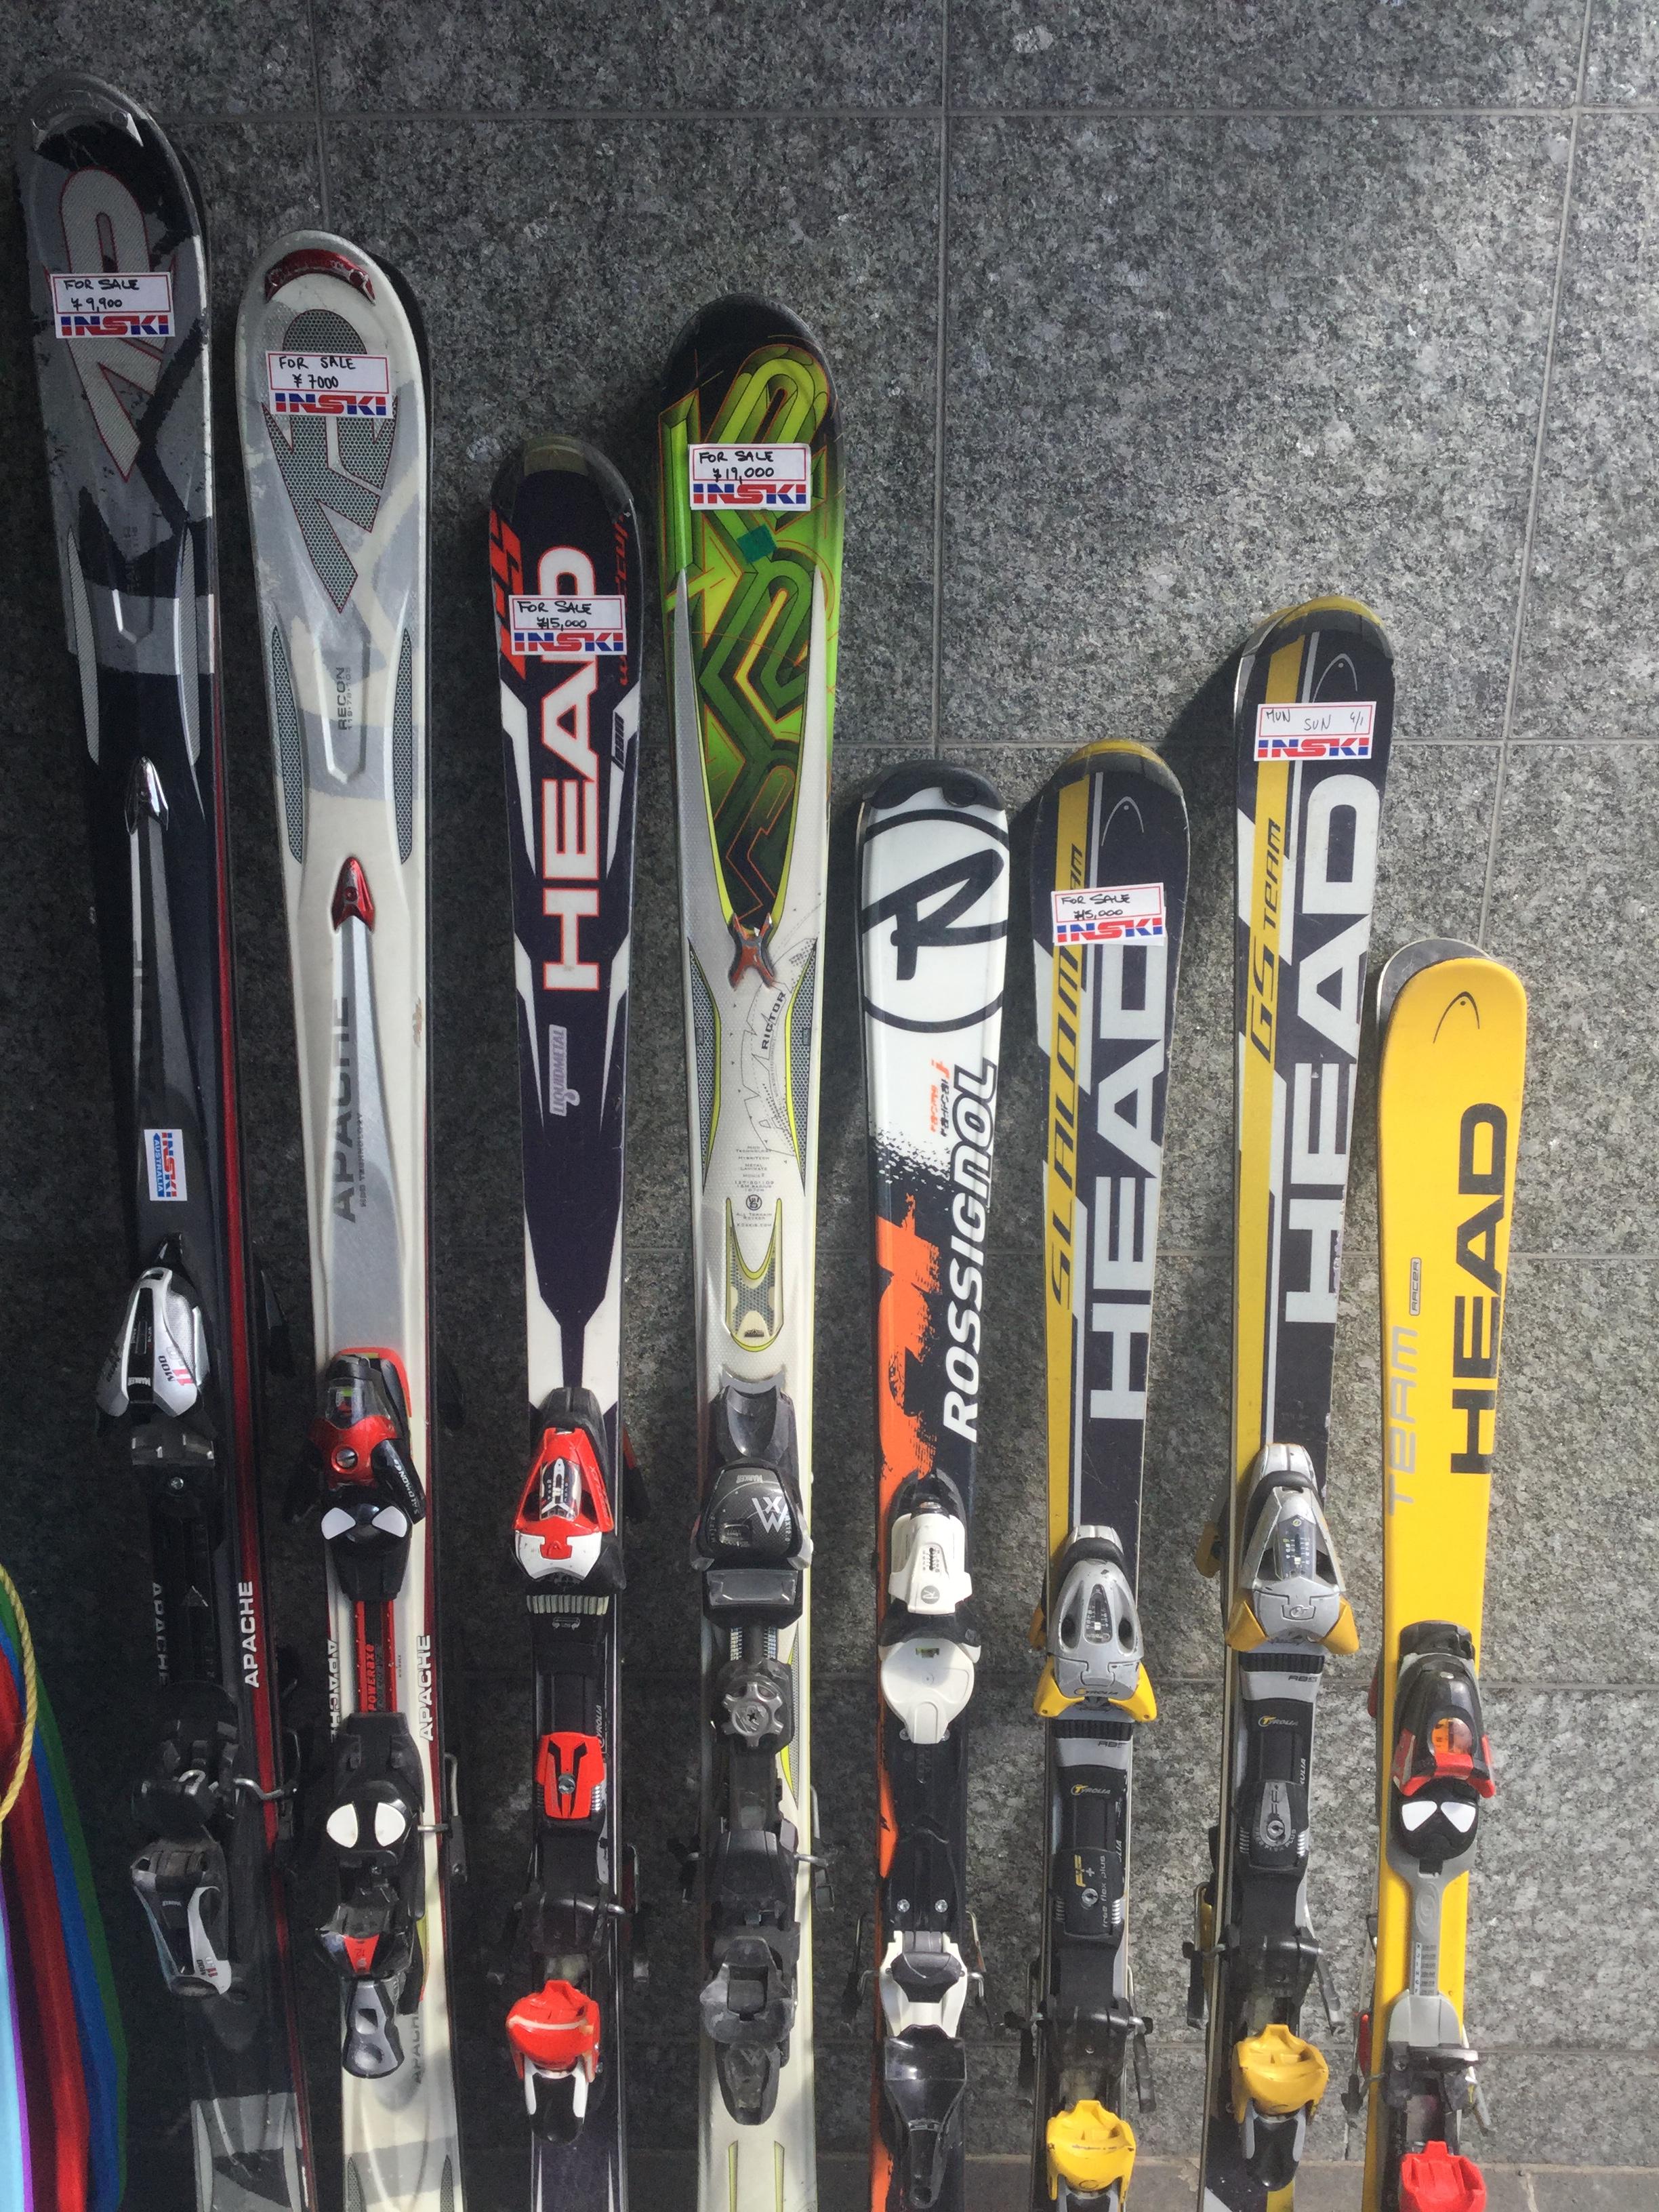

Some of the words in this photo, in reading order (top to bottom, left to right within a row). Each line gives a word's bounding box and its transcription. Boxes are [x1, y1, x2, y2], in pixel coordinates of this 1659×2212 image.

[64, 278, 92, 291] FOR
[99, 278, 140, 291] SALE
[61, 315, 169, 337] INSKI
[279, 356, 309, 371] FOR
[321, 356, 356, 371] SALE
[274, 392, 388, 415] INSKI
[699, 451, 728, 464] FOR
[737, 451, 774, 464] SALE
[693, 483, 807, 505] INSKI
[518, 601, 549, 614] FOR
[555, 601, 592, 615] SALE
[513, 632, 623, 652] INSKI
[336, 667, 347, 731] RECON
[1303, 714, 1331, 731] SUN
[1257, 737, 1370, 759] INSKI
[1061, 896, 1085, 905] FOR
[1090, 894, 1131, 905] SALE
[1057, 918, 1163, 943] INSKI
[761, 991, 787, 1049] RICTOR
[1250, 935, 1275, 1063] GS
[552, 1030, 565, 1113] LIQUIDMETAL
[1286, 774, 1380, 1323] HEAD
[331, 997, 356, 1223] APACHE
[1050, 946, 1079, 1309] SLALOM
[154, 1139, 163, 1192] AUSTRALIA
[161, 1132, 177, 1197] INSKI
[1090, 943, 1168, 1419] HEAD
[944, 1056, 998, 1443] ROSSIGNOL
[1411, 1261, 1419, 1313] RACER
[1450, 1103, 1507, 1474] HEAD
[736, 1474, 764, 1484] MARKER
[239, 1580, 260, 1689] APACHE
[417, 1634, 433, 1742] APACHE
